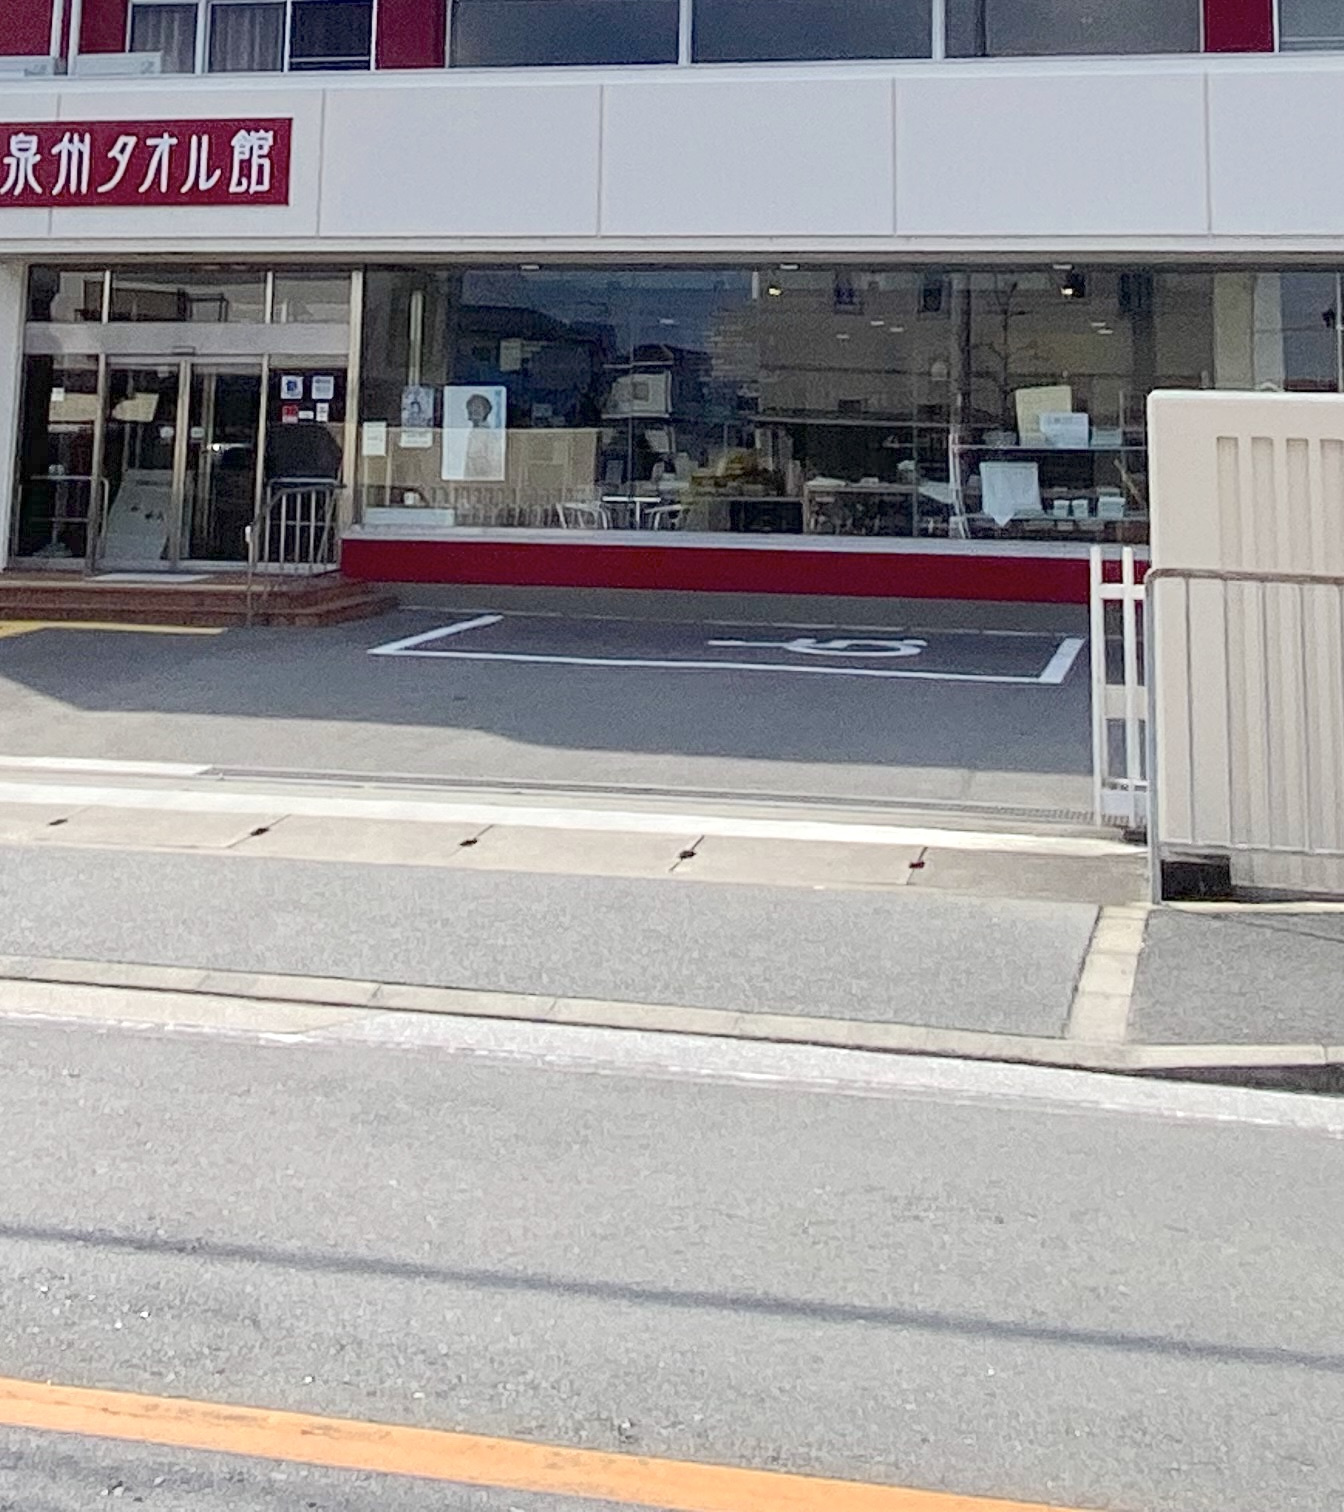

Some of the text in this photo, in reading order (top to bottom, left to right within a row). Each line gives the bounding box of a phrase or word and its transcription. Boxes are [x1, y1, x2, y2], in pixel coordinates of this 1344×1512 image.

[0, 129, 274, 195] 泉州タオル館
